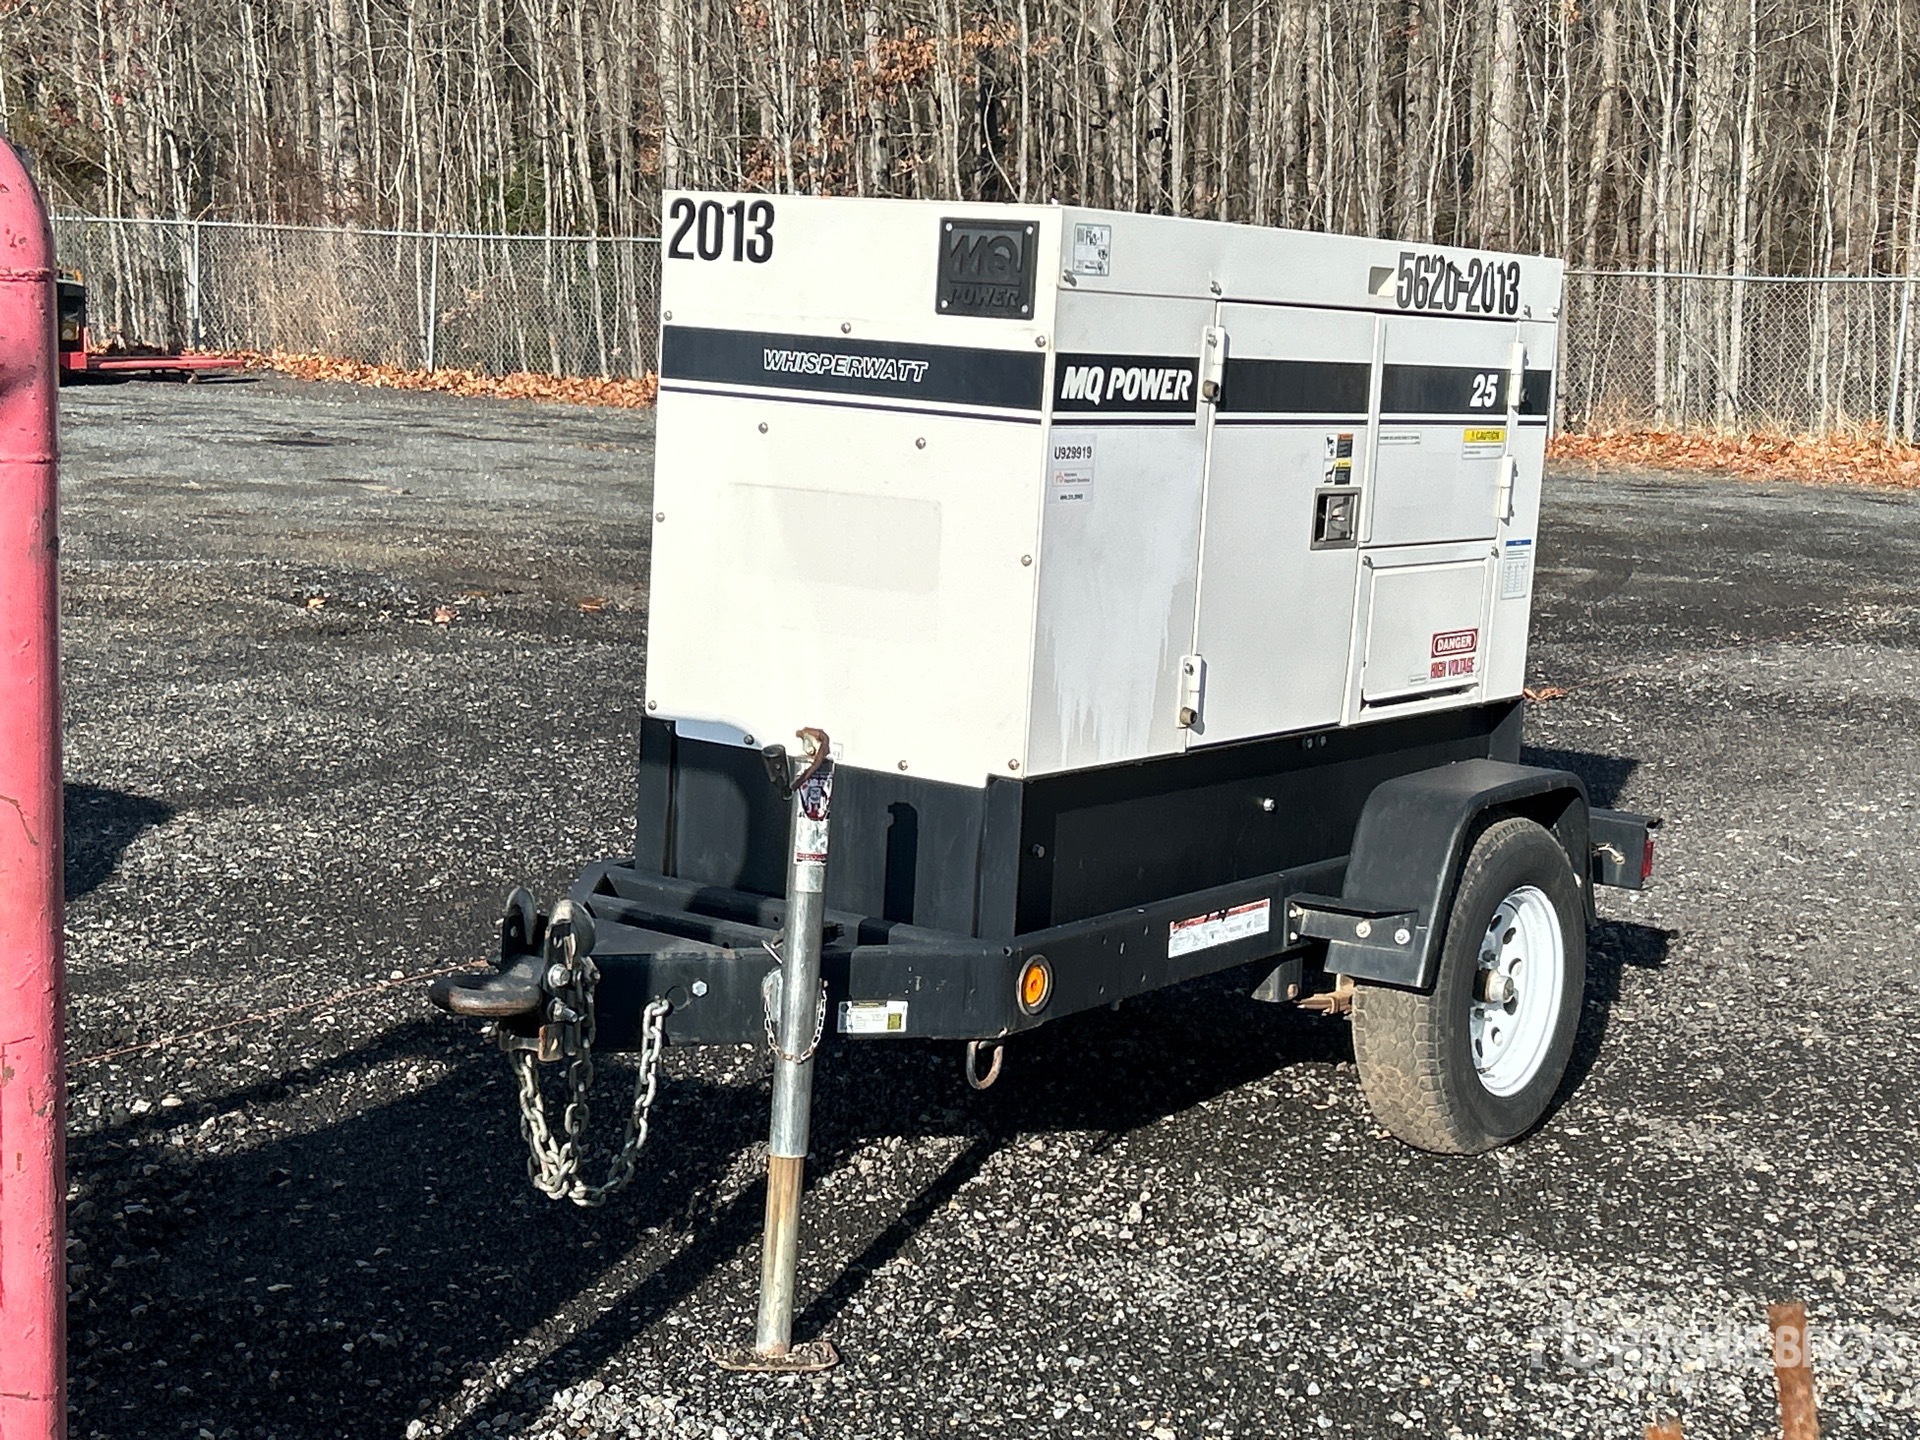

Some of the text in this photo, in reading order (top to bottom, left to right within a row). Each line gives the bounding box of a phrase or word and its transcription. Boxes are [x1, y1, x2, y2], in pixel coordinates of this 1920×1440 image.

[668, 199, 775, 263] 2013
[949, 234, 1021, 280] MQ
[1397, 252, 1520, 315] 5620-2013
[763, 348, 928, 382] WHISPERWATT
[1061, 366, 1192, 405] MQ POWER
[1469, 374, 1498, 408] 25
[1437, 635, 1472, 651] DANGER
[1430, 661, 1446, 679] HIGH
